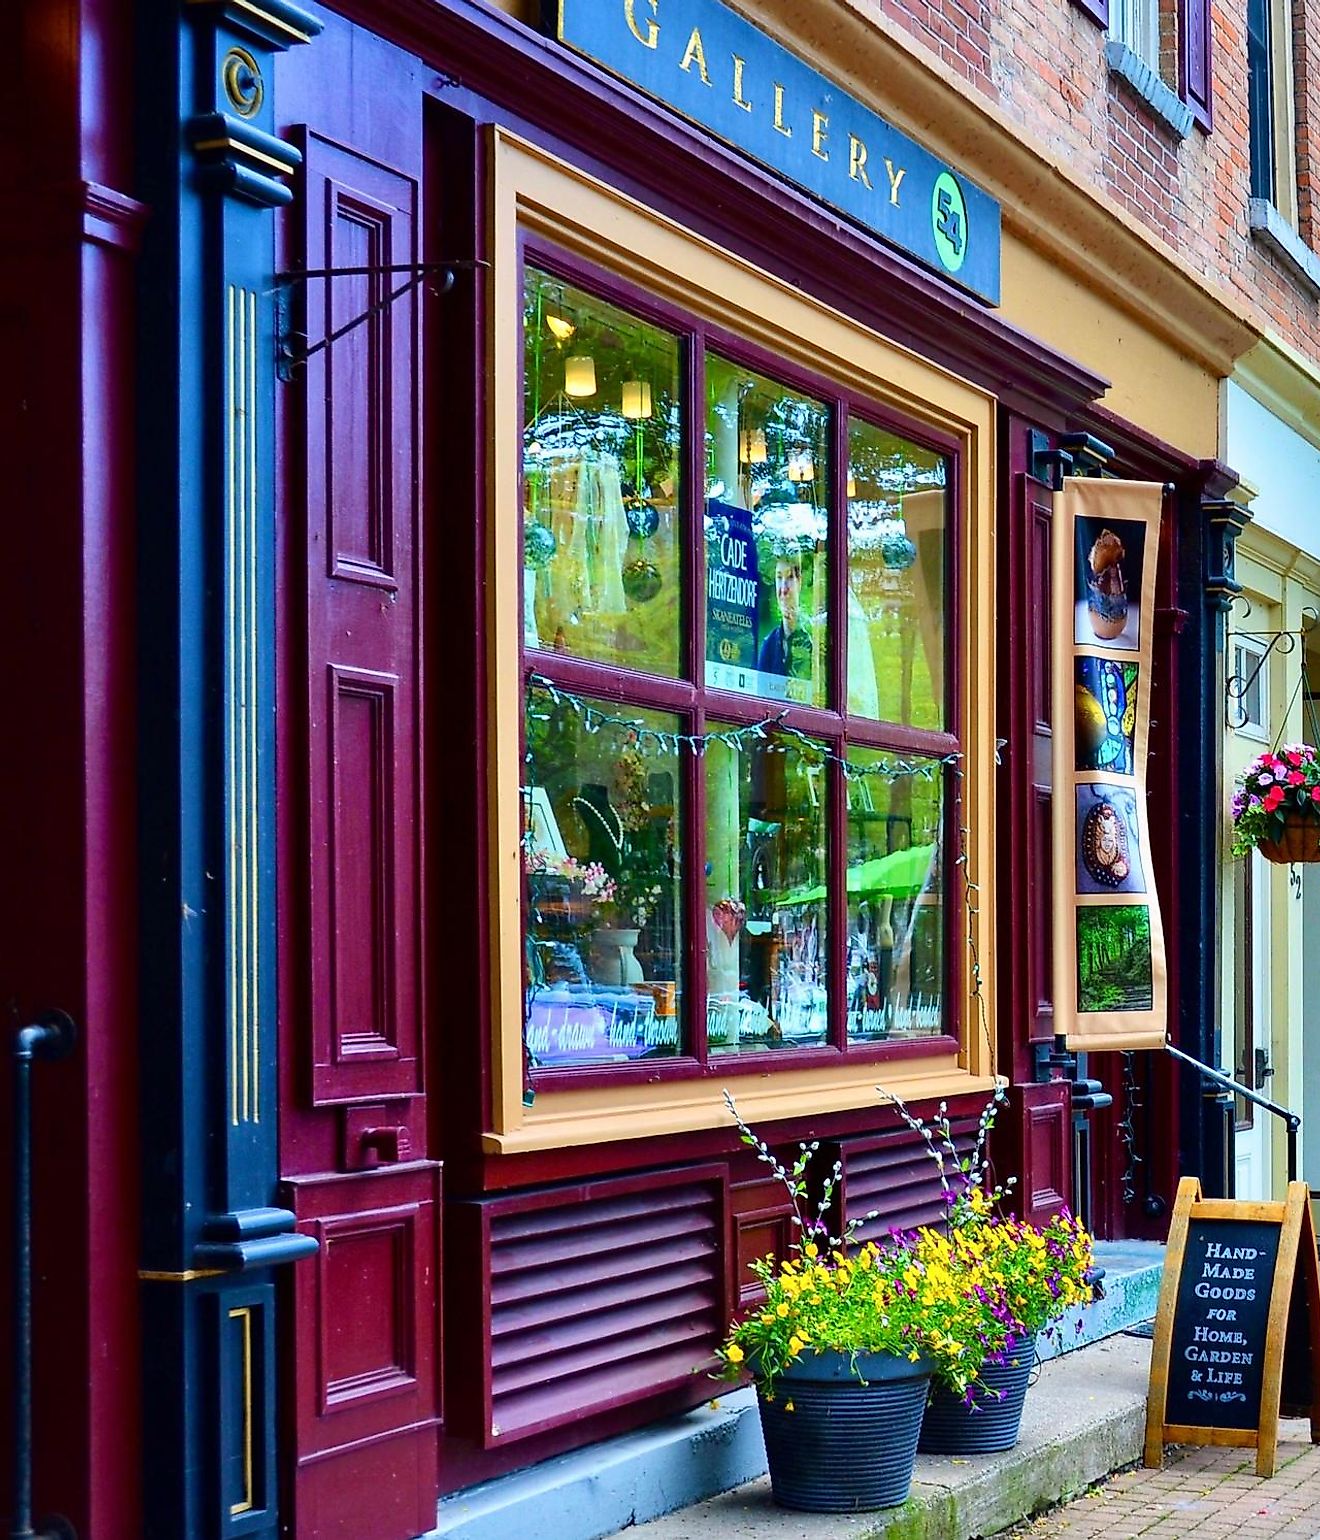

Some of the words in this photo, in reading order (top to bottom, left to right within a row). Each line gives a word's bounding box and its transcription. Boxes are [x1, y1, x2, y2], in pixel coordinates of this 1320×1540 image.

[623, 0, 908, 207] GALLERY
[936, 187, 962, 256] 54
[720, 533, 748, 571] CADE
[1201, 1263, 1255, 1280] MADE
[1194, 1283, 1256, 1301] GOODS
[1193, 1326, 1248, 1345] HOME,
[1184, 1346, 1254, 1366] GARDEN
[1190, 1369, 1203, 1384] &
[1206, 1368, 1244, 1385] LIFE
